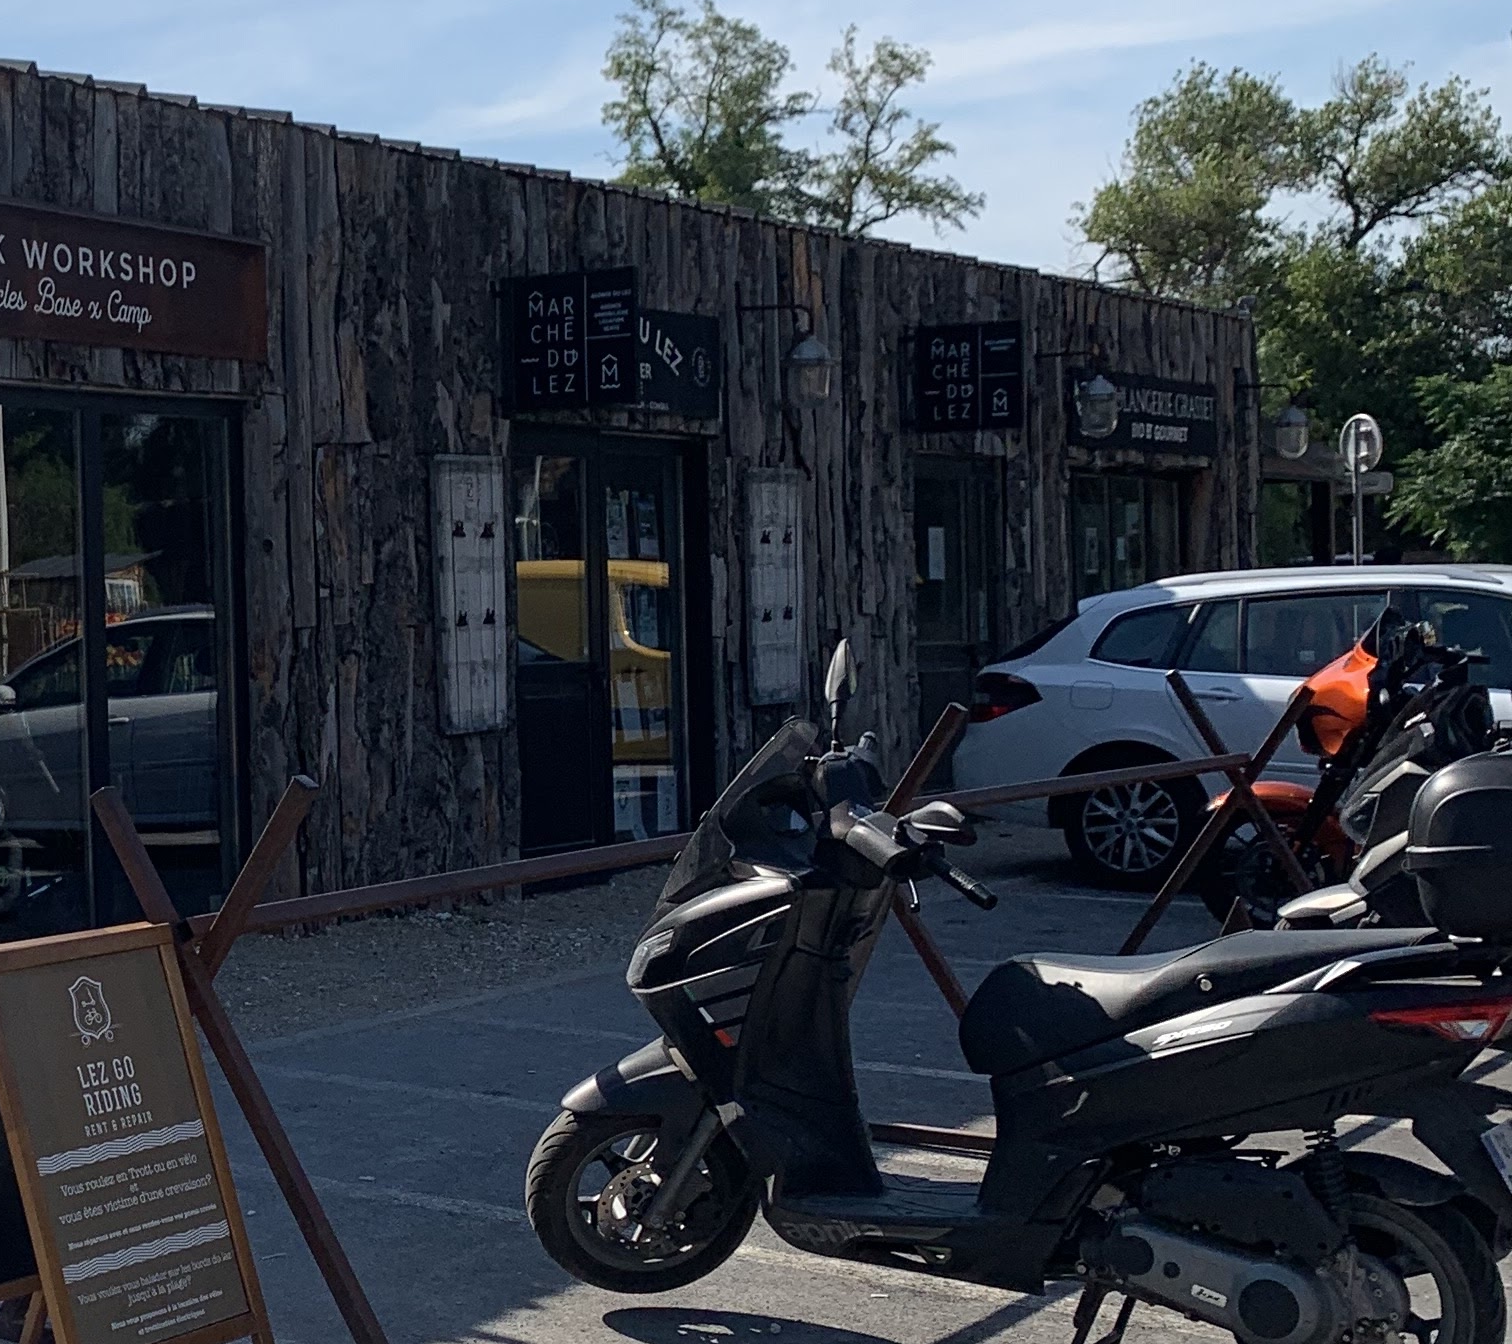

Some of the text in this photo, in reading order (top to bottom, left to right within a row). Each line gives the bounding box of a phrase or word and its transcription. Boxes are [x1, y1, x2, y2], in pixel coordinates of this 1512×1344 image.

[22, 239, 196, 289] WORKSHOP
[34, 277, 83, 319] Base
[107, 289, 152, 333] Camp
[528, 296, 574, 318] MAR
[655, 329, 683, 376] LEZ
[930, 343, 971, 360] MAR
[533, 374, 575, 395] LEZ
[934, 403, 971, 421] LEZ
[76, 1055, 135, 1089] LEZ GO
[83, 1082, 142, 1117] RIDING
[85, 1122, 108, 1137] RENT
[120, 1111, 153, 1130] REPAIR
[60, 1183, 85, 1197] Vous
[84, 1176, 116, 1193] roulez
[116, 1172, 128, 1183] en
[153, 1162, 166, 1173] ou
[166, 1159, 178, 1170] en
[58, 1174, 213, 1225] vous êtes victime d'une crevaison?
